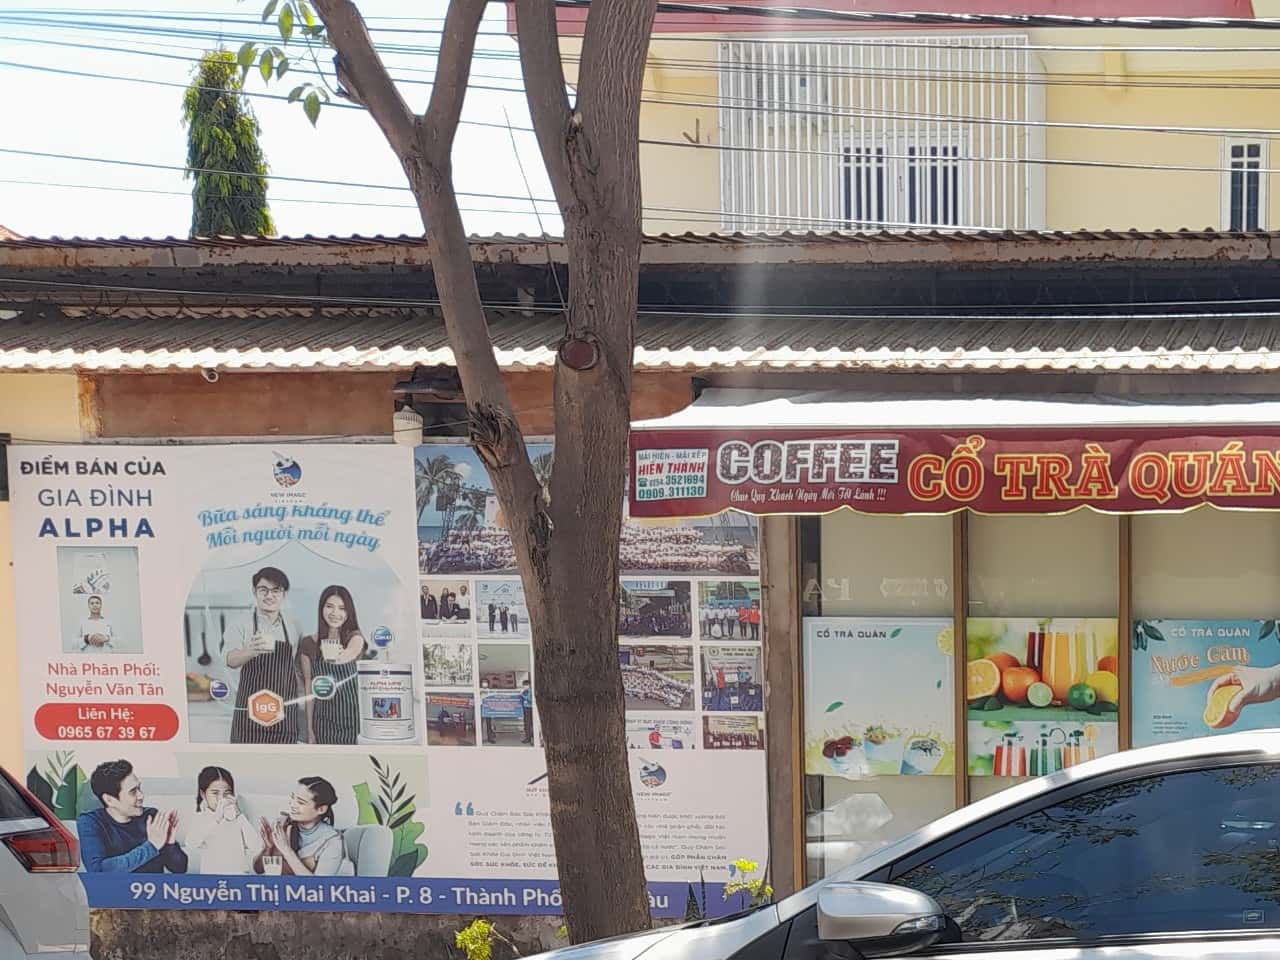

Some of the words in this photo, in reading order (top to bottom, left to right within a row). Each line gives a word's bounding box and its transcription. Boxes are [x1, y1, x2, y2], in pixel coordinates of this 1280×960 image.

[20, 455, 69, 475] ĐIỂM
[76, 457, 118, 475] BÁN
[124, 456, 166, 475] CỦA
[716, 439, 899, 485] COFFEE
[907, 435, 985, 501] CỔ
[993, 443, 1119, 500] TRÀ
[38, 489, 82, 507] GIA
[90, 484, 152, 507] ĐÌNH
[198, 508, 238, 527] Bữa
[242, 502, 286, 521] sáng
[291, 502, 350, 524] kháng
[38, 517, 155, 538] ALPHA
[206, 526, 238, 549] Mỗi
[242, 524, 293, 545] người
[297, 522, 329, 541] mỗi
[334, 530, 381, 551] ngày
[47, 663, 77, 676] Nhà
[82, 663, 118, 676] Phân
[123, 662, 160, 676] Phối:
[46, 680, 102, 697] Nguyễn
[106, 682, 133, 696] Văn
[138, 683, 164, 696] Tân
[78, 707, 107, 720] Liên
[111, 707, 134, 722] Hệ:
[58, 726, 92, 738] 0965
[96, 726, 113, 738] 67
[118, 726, 135, 738] 39
[139, 726, 156, 738] 67
[130, 882, 155, 899] 99
[163, 880, 242, 904] Nguyễn
[247, 884, 280, 905] Thị
[286, 884, 324, 902] Mai
[330, 885, 376, 903] Khai
[395, 886, 413, 904] P.
[419, 886, 433, 904] 8
[451, 887, 516, 906] Thành
